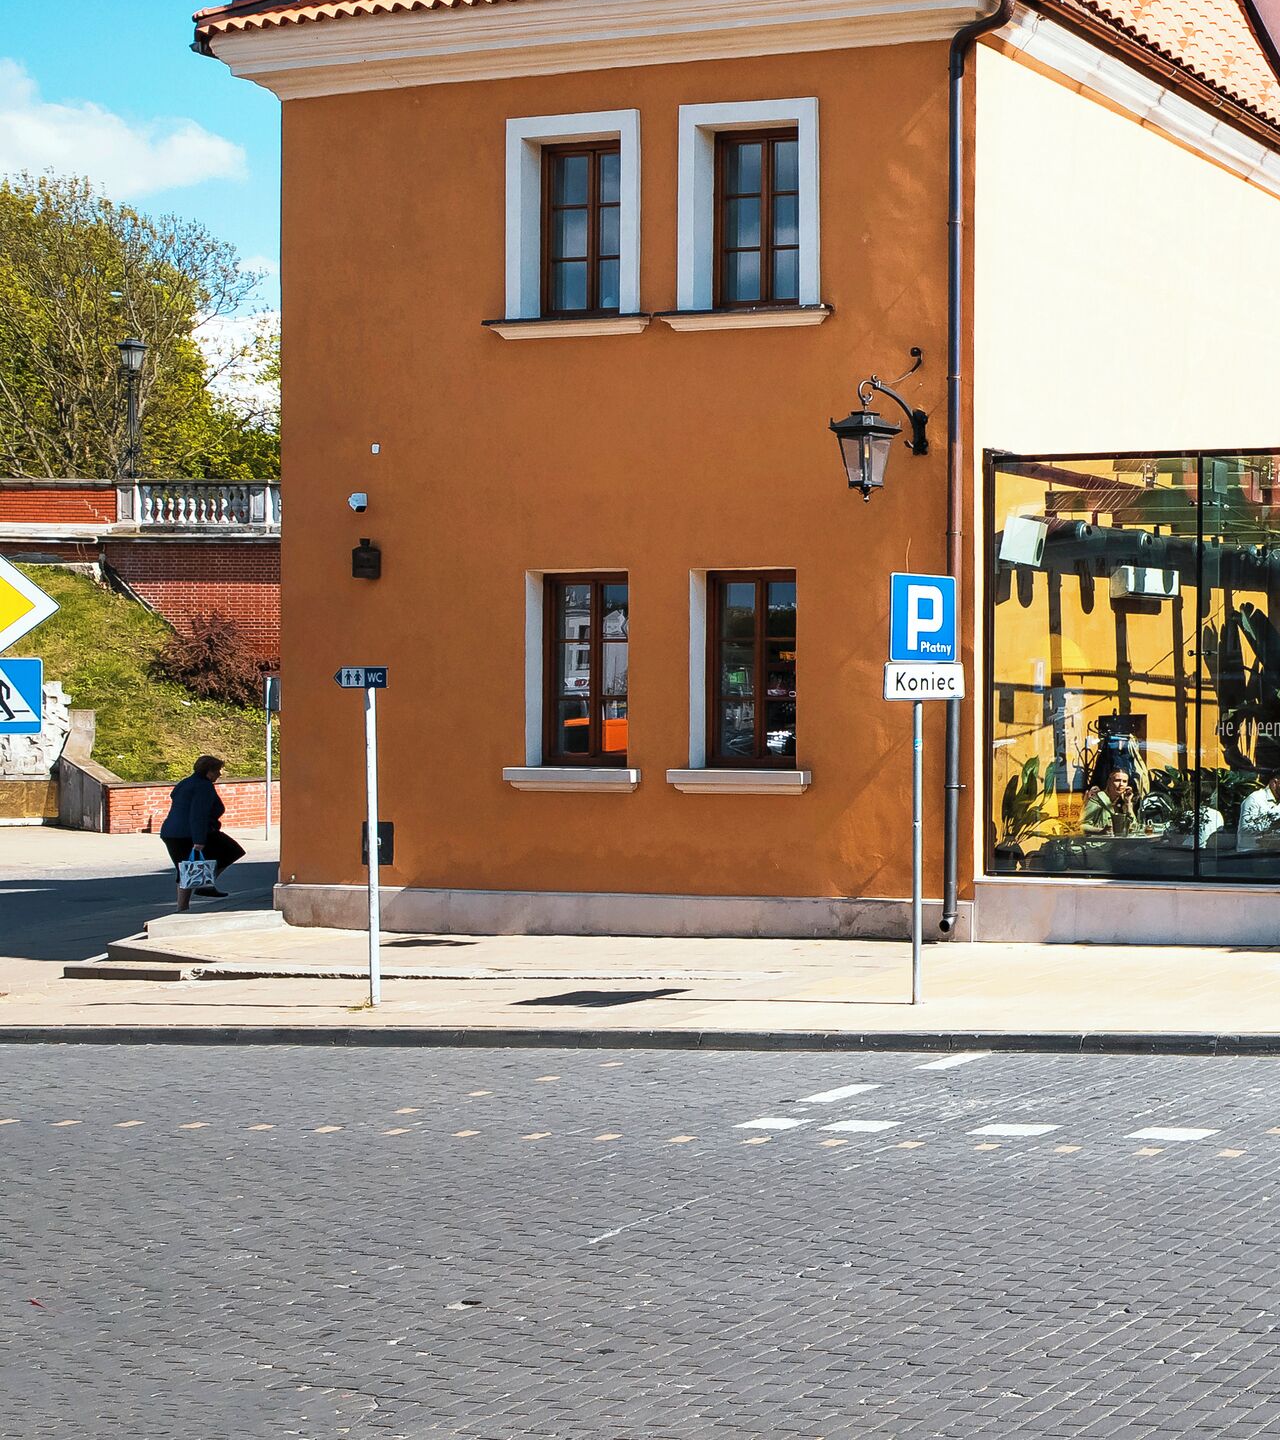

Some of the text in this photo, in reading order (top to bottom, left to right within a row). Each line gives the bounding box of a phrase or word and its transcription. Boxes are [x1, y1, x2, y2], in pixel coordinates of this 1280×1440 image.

[907, 584, 943, 651] P
[920, 640, 952, 656] Płatny
[367, 672, 383, 683] WC
[895, 671, 955, 691] Koniec
